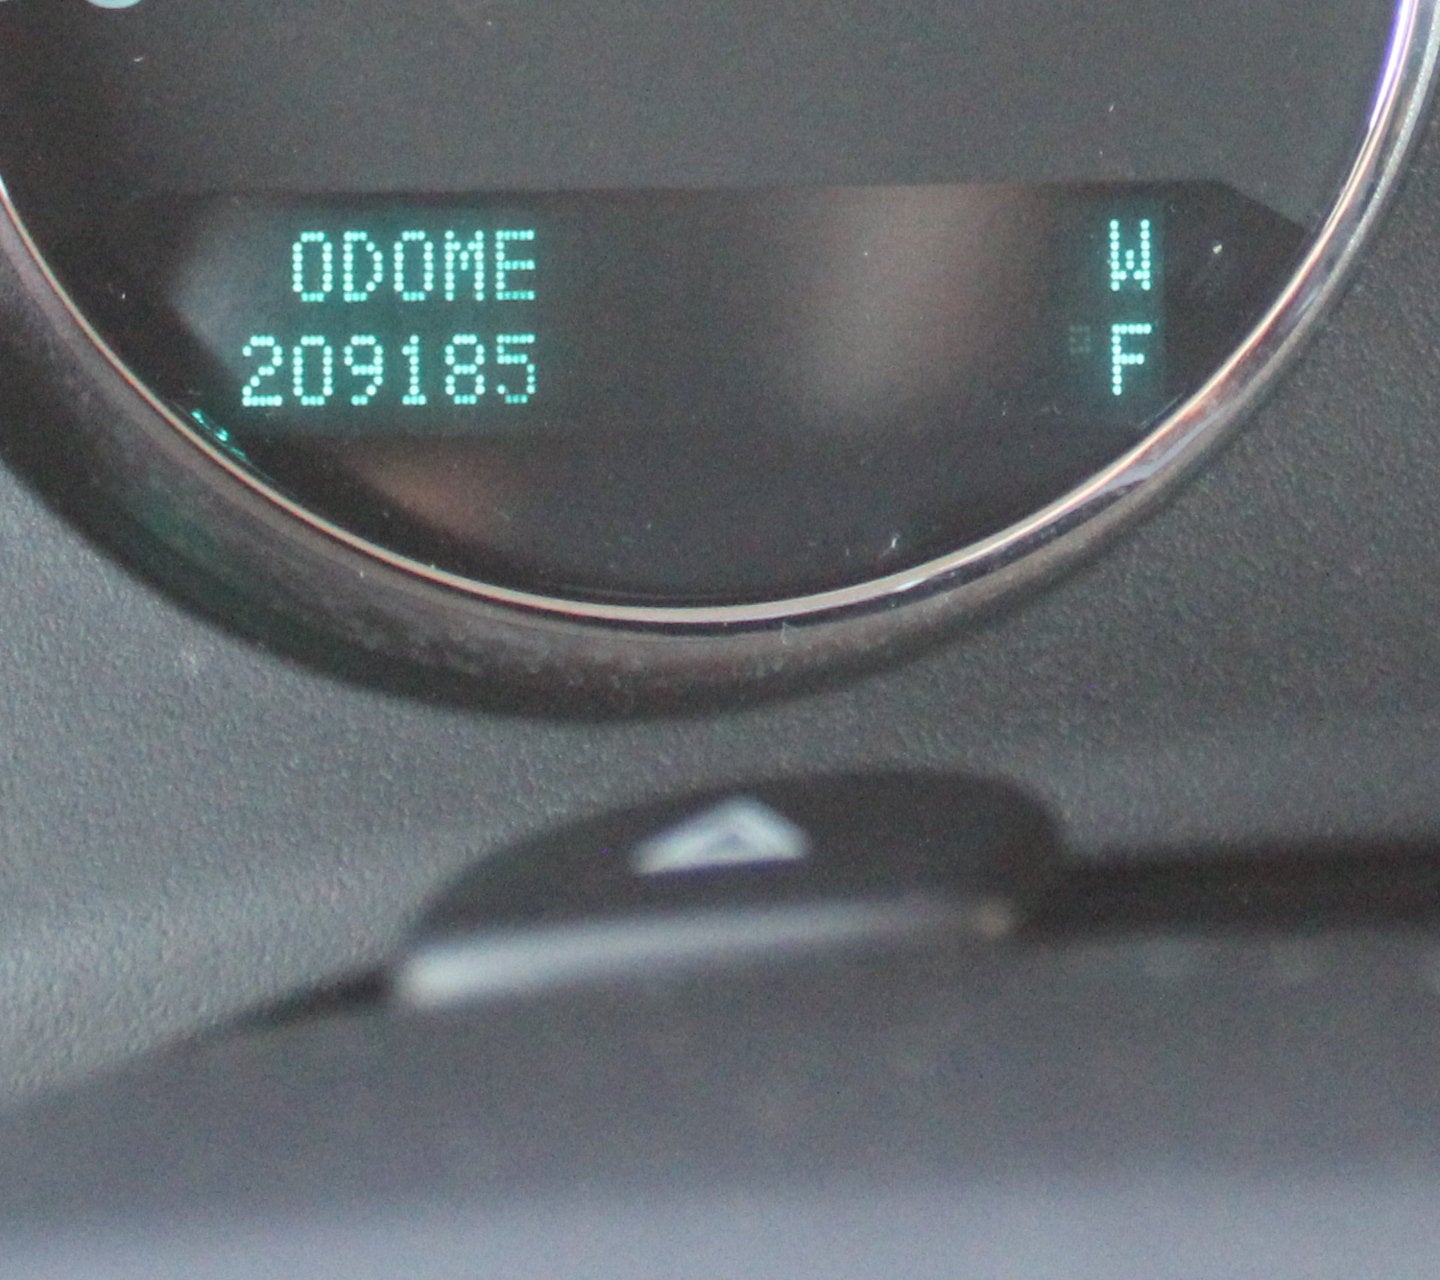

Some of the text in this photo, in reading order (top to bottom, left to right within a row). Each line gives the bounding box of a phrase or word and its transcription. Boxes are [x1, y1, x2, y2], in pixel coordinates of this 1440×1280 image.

[293, 230, 535, 302] ODOME
[1109, 220, 1151, 291] W
[242, 334, 535, 406] 209185
[1111, 323, 1152, 395] F
